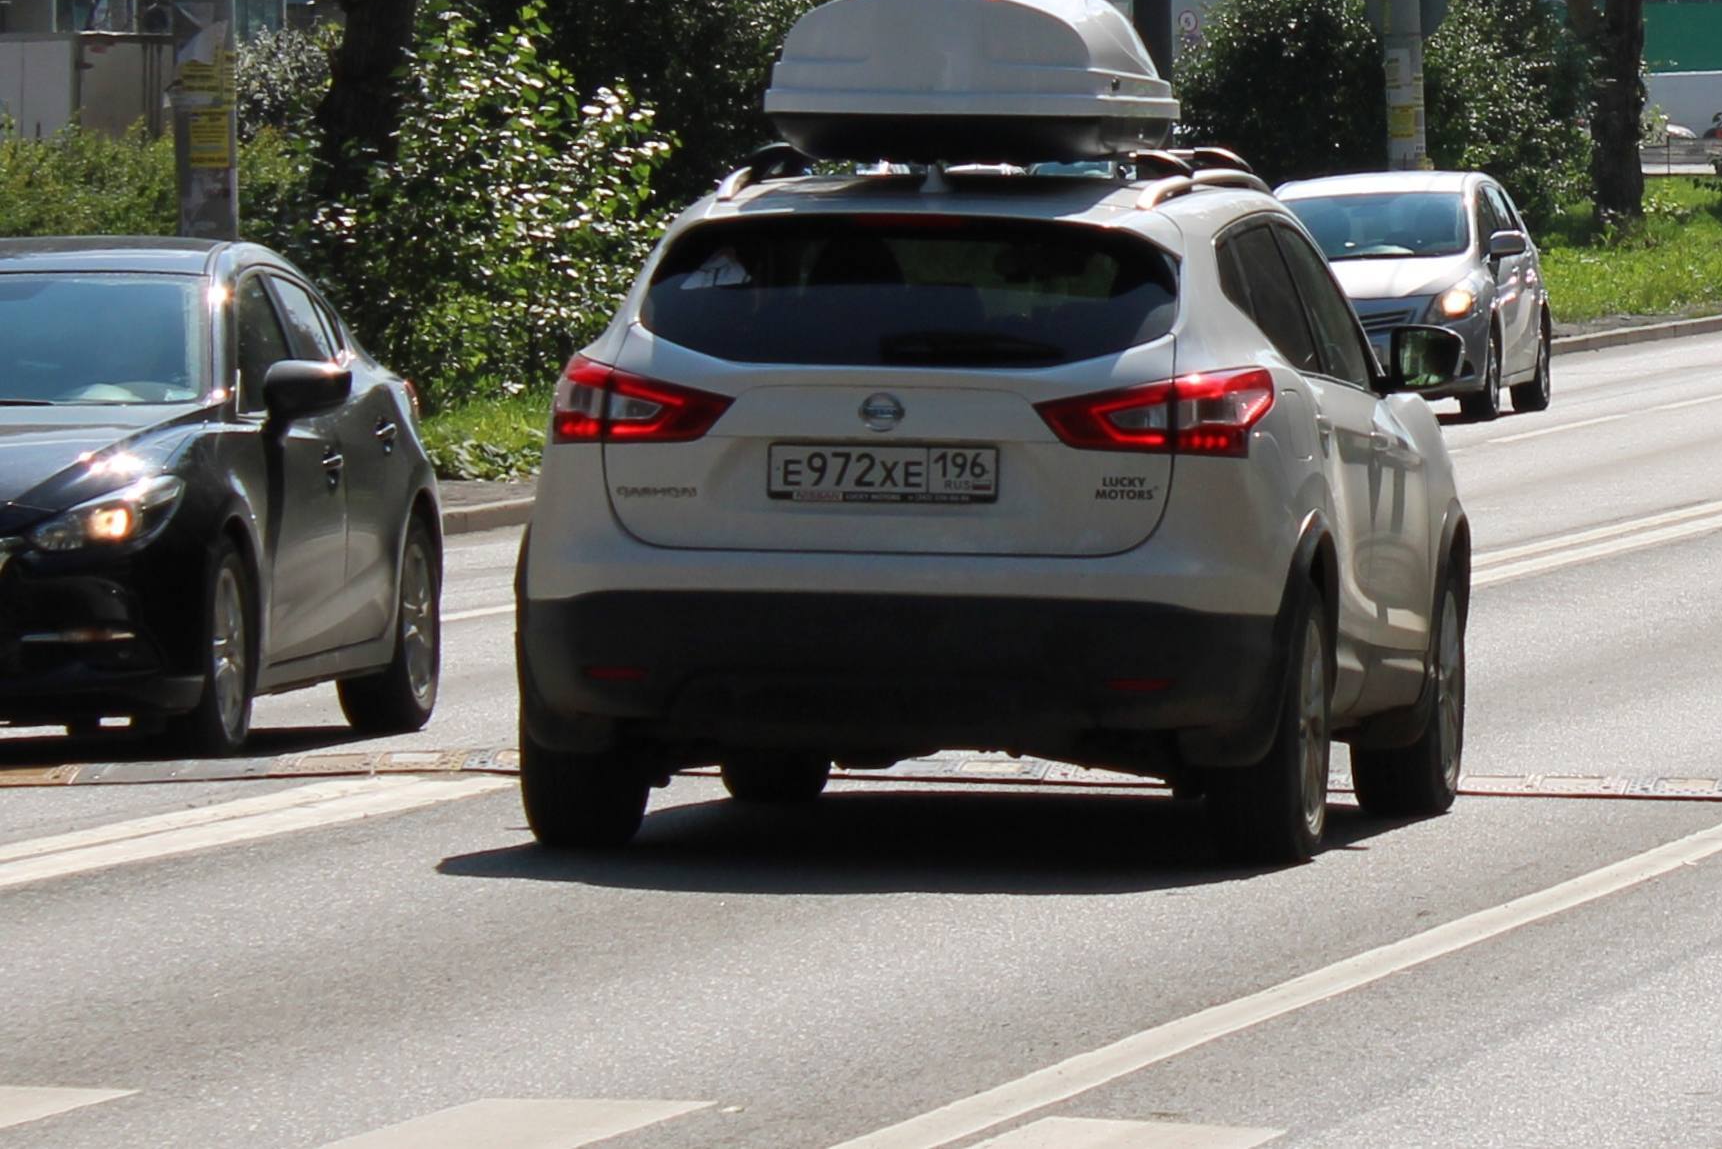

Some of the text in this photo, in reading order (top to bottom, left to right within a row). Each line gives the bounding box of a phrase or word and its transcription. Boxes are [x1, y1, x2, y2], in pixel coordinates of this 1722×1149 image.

[934, 452, 986, 479] 196
[944, 480, 971, 490] RUS
[1101, 476, 1147, 488] LUCKY
[1094, 488, 1154, 500] MOTORS
